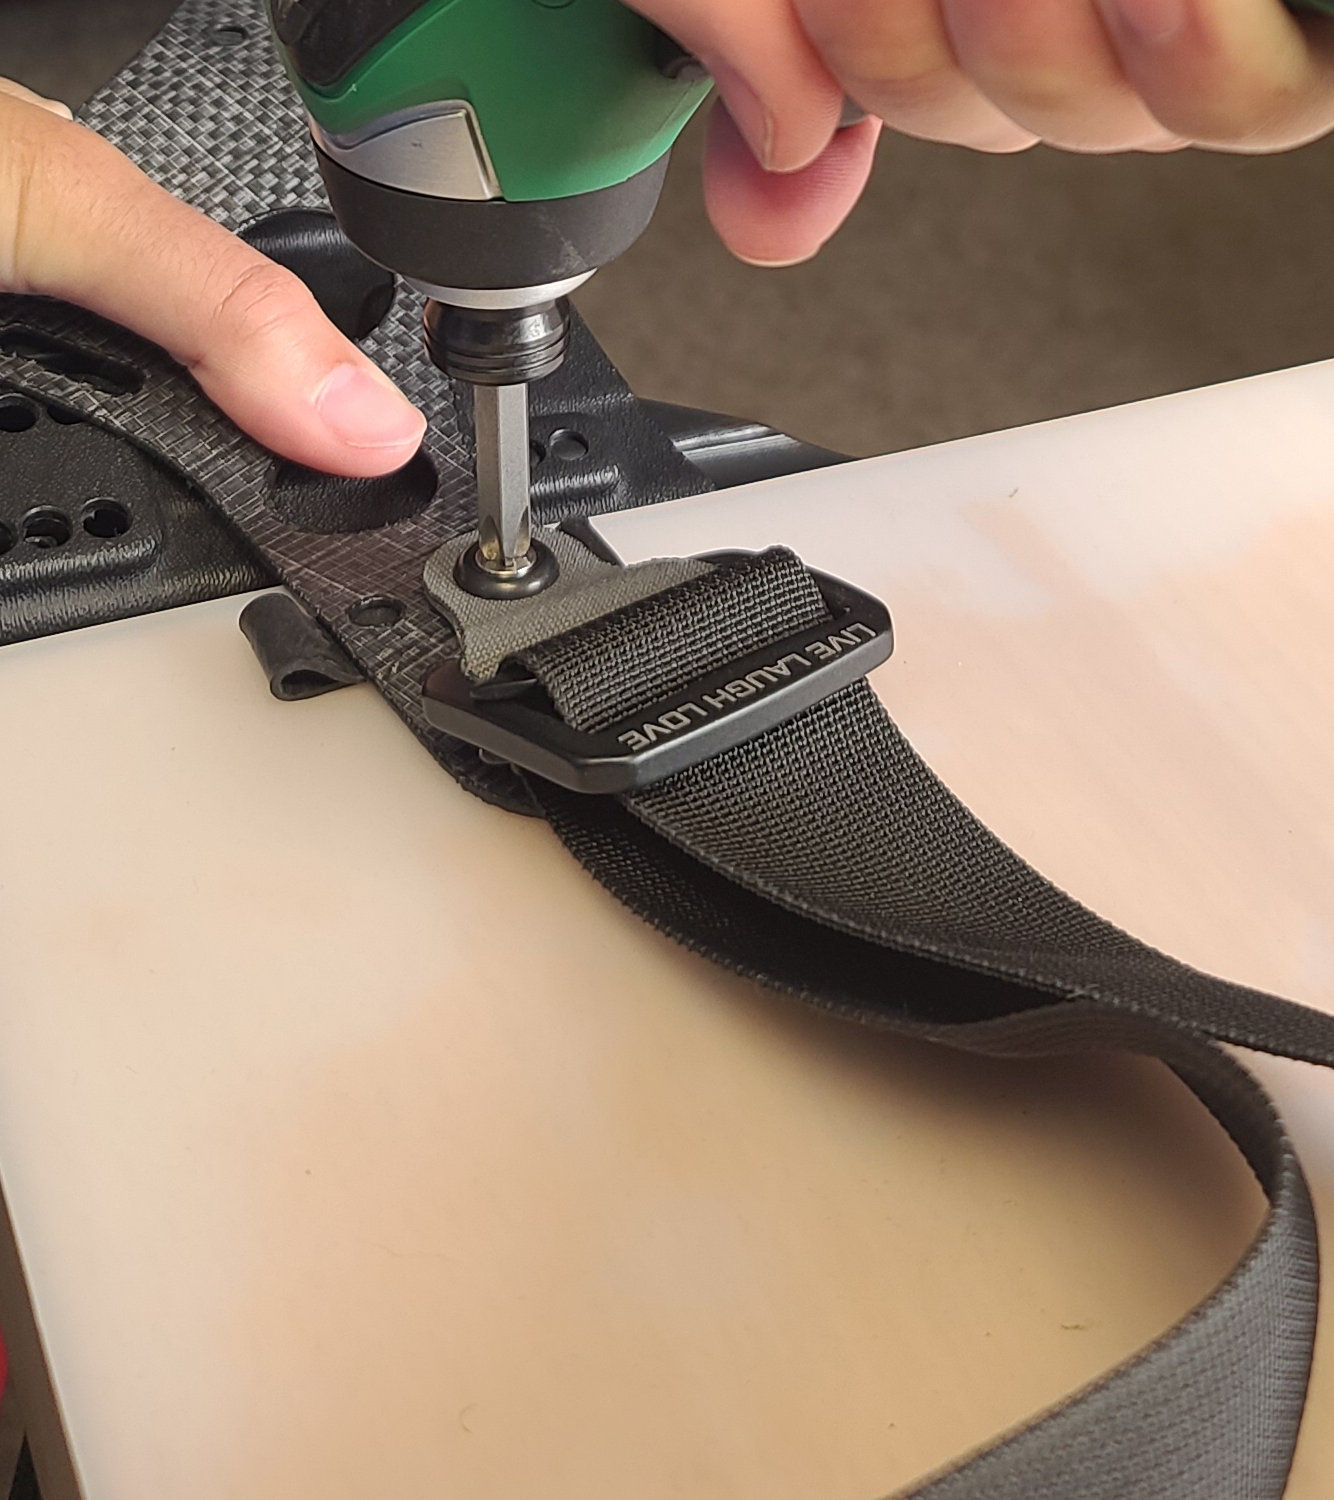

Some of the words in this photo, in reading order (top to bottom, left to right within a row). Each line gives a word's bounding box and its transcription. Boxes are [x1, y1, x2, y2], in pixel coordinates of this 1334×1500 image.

[804, 621, 878, 661] LIVE
[701, 652, 812, 709] LAUGH
[616, 700, 708, 751] LOVE
